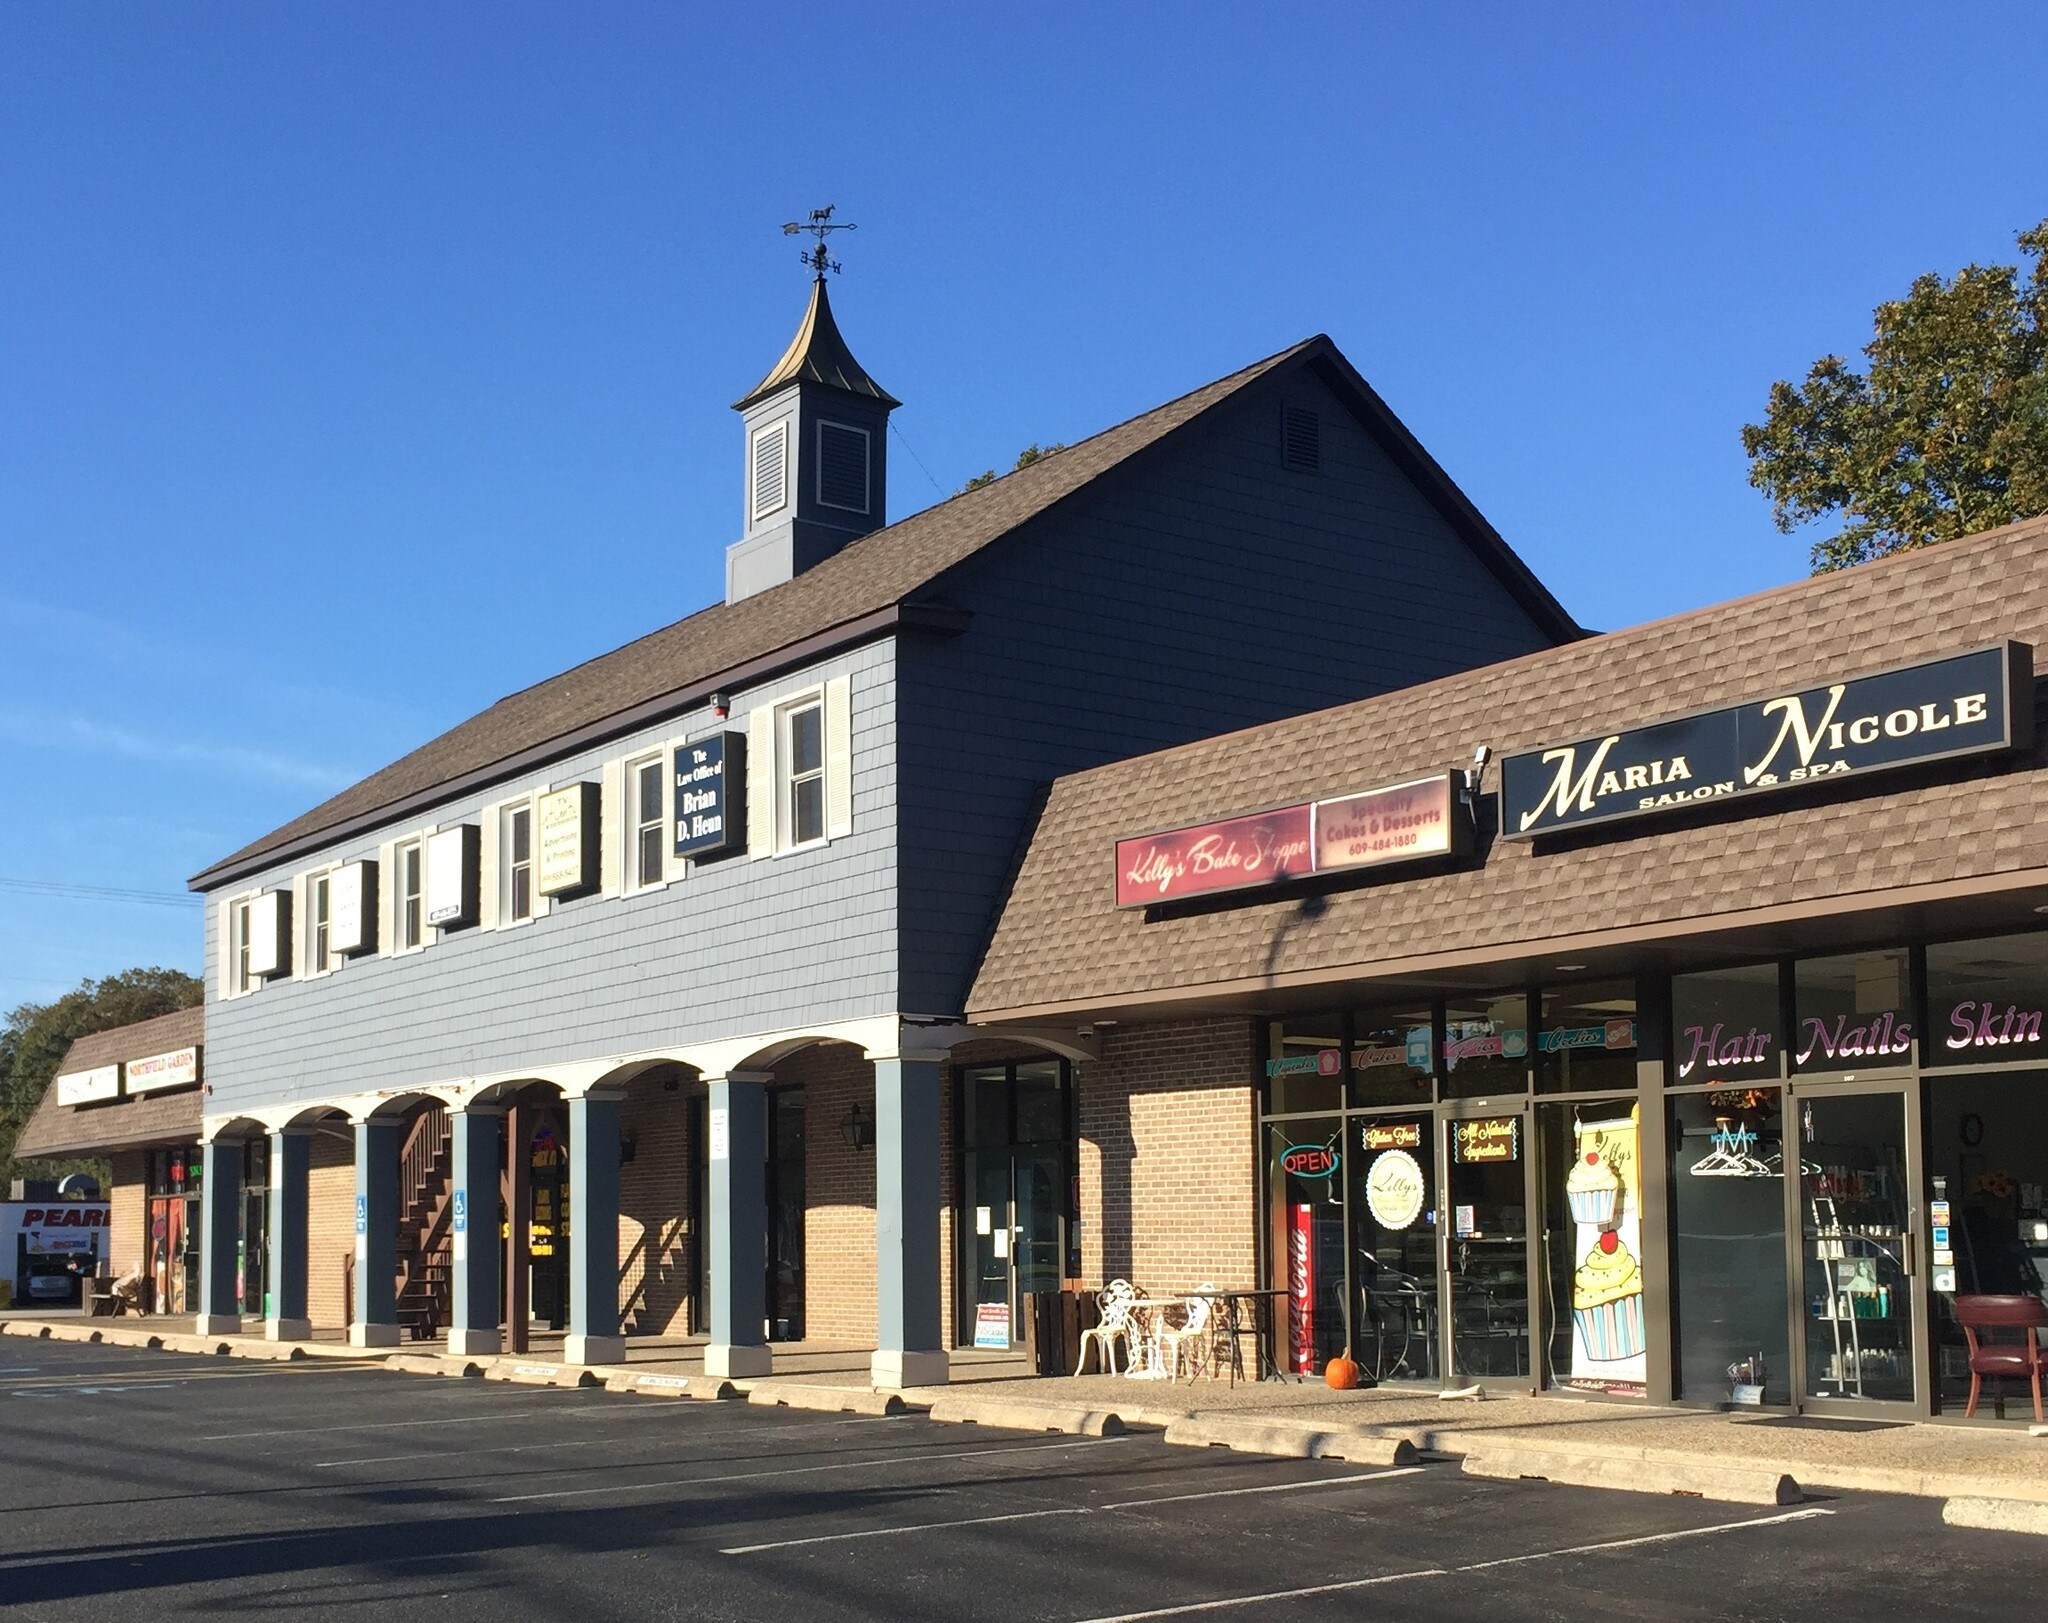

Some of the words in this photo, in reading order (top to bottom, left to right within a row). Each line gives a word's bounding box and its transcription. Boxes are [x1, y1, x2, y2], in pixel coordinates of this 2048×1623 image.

[692, 750, 707, 764] The
[1520, 736, 1692, 831] MARIA
[1743, 684, 1988, 785] NICOLE
[677, 773, 693, 787] Law
[692, 765, 714, 781] Office
[714, 760, 722, 775] of
[1639, 782, 1735, 810] SALON
[1757, 772, 1780, 787] &
[1790, 759, 1852, 782] SPA
[683, 789, 717, 815] Brian
[1351, 796, 1413, 821] Specialty
[677, 820, 691, 842] D.
[1326, 824, 1366, 842] Cakes
[1383, 809, 1441, 833] Desserts
[1349, 833, 1417, 856] 609-484-1880
[1127, 846, 1187, 893] Kelly's
[1186, 833, 1242, 874] Bake
[1243, 824, 1307, 871] Shoppe
[1946, 1001, 2042, 1049] Skin
[1546, 1025, 1599, 1054] Cookies
[1679, 1023, 1772, 1078] Hair
[1796, 1012, 1913, 1065] Nails
[129, 1057, 165, 1077] NORTHFIELD
[167, 1052, 193, 1070] GARDEN
[1270, 1056, 1315, 1079] Cupcakes
[1358, 1044, 1398, 1071] Cakes
[1365, 1129, 1393, 1149] Gluten
[1393, 1127, 1417, 1146] Free
[1458, 1122, 1479, 1143] All
[1478, 1120, 1513, 1140] Natural
[1284, 1151, 1333, 1173] OPEN
[1463, 1142, 1507, 1161] Ingredients
